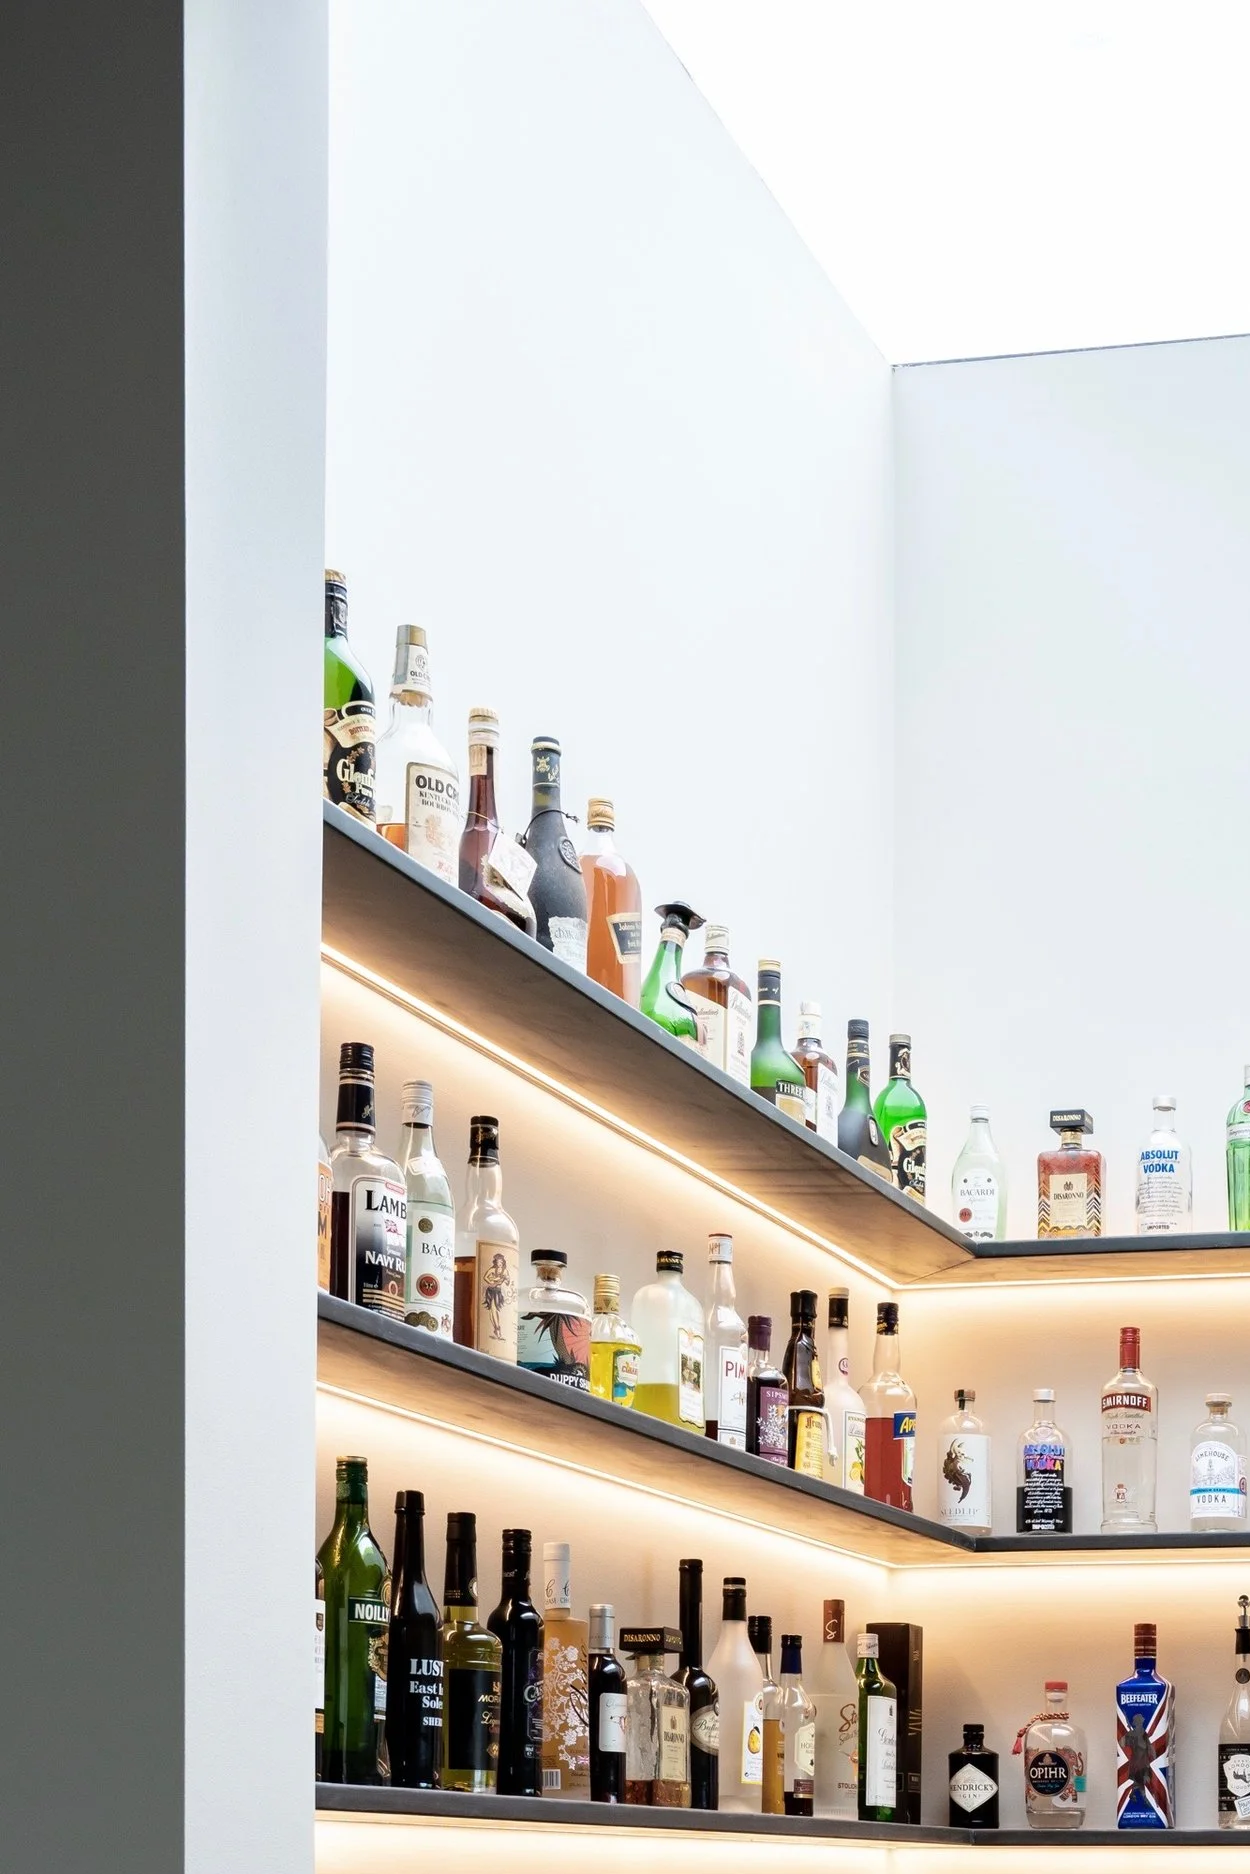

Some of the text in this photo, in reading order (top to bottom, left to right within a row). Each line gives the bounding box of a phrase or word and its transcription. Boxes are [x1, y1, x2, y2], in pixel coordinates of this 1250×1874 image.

[415, 775, 445, 794] OLD
[778, 1081, 803, 1099] THREE
[1140, 1149, 1179, 1161] ABSOLUT
[1143, 1163, 1175, 1174] VODKA
[960, 1188, 995, 1197] BACARDI
[1053, 1191, 1084, 1201] DISARONNO
[365, 1189, 407, 1220] LAMB
[365, 1250, 394, 1268] NAVY
[550, 1373, 580, 1387] DUPPY
[1102, 1395, 1148, 1409] SMIRNOFF
[1195, 1450, 1230, 1462] LIMEHOUSE
[1197, 1495, 1227, 1504] VODKA
[354, 1603, 391, 1622] NOILLY
[623, 1633, 661, 1643] DISARONNO
[409, 1681, 438, 1695] East
[1121, 1693, 1158, 1706] BEEFEATER
[664, 1731, 685, 1744] DISARONNO
[1029, 1767, 1067, 1779] OPIHR
